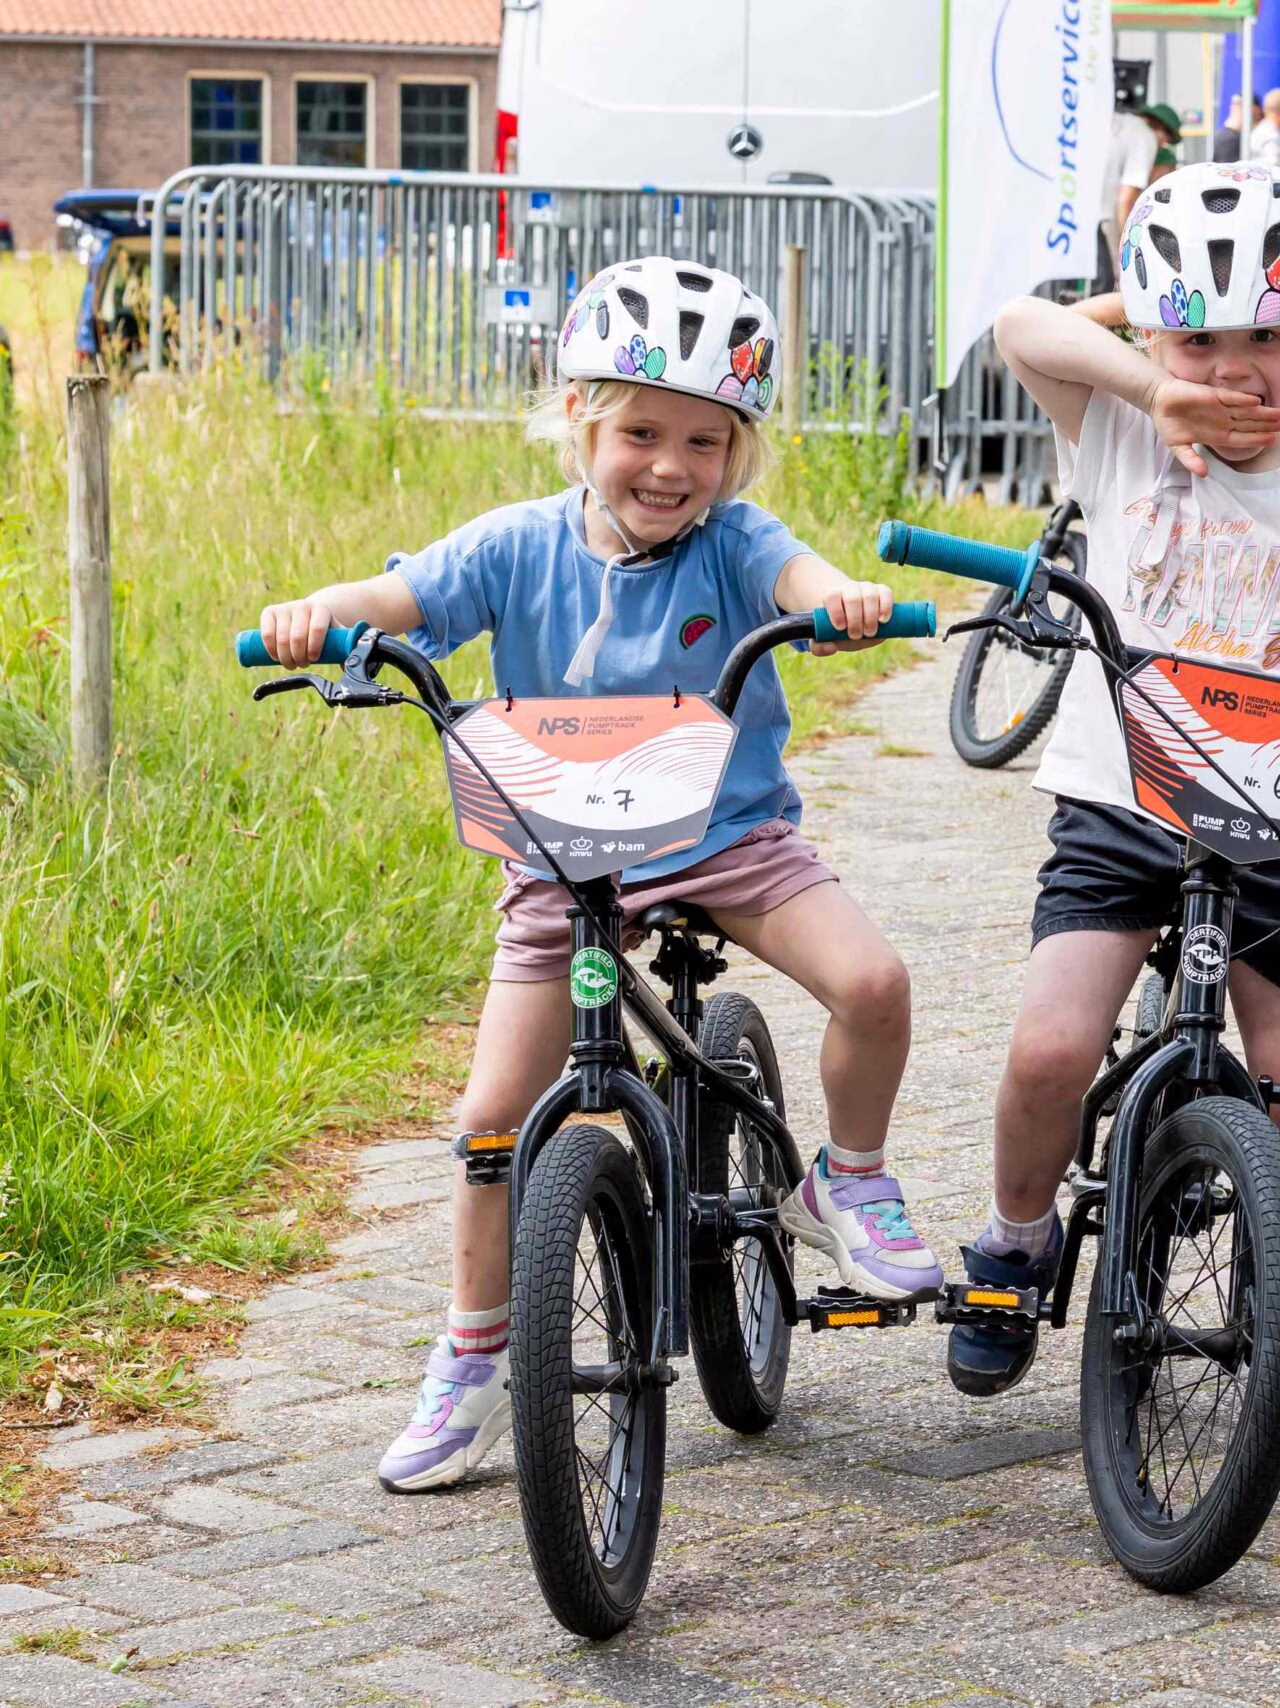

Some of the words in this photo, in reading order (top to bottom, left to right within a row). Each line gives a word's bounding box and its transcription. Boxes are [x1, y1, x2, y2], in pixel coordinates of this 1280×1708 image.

[1046, 0, 1081, 254] Sportservic
[1173, 621, 1256, 660] Aloha
[1200, 686, 1239, 712] NPS
[537, 716, 581, 736] NPS
[1243, 775, 1262, 789] Nr.
[585, 793, 606, 805] Nr.
[613, 789, 635, 812] 7
[1199, 815, 1225, 827] PUMP
[618, 841, 645, 852] bam
[1189, 927, 1227, 947] CERTIFIED
[574, 950, 613, 968] CERTIFIED
